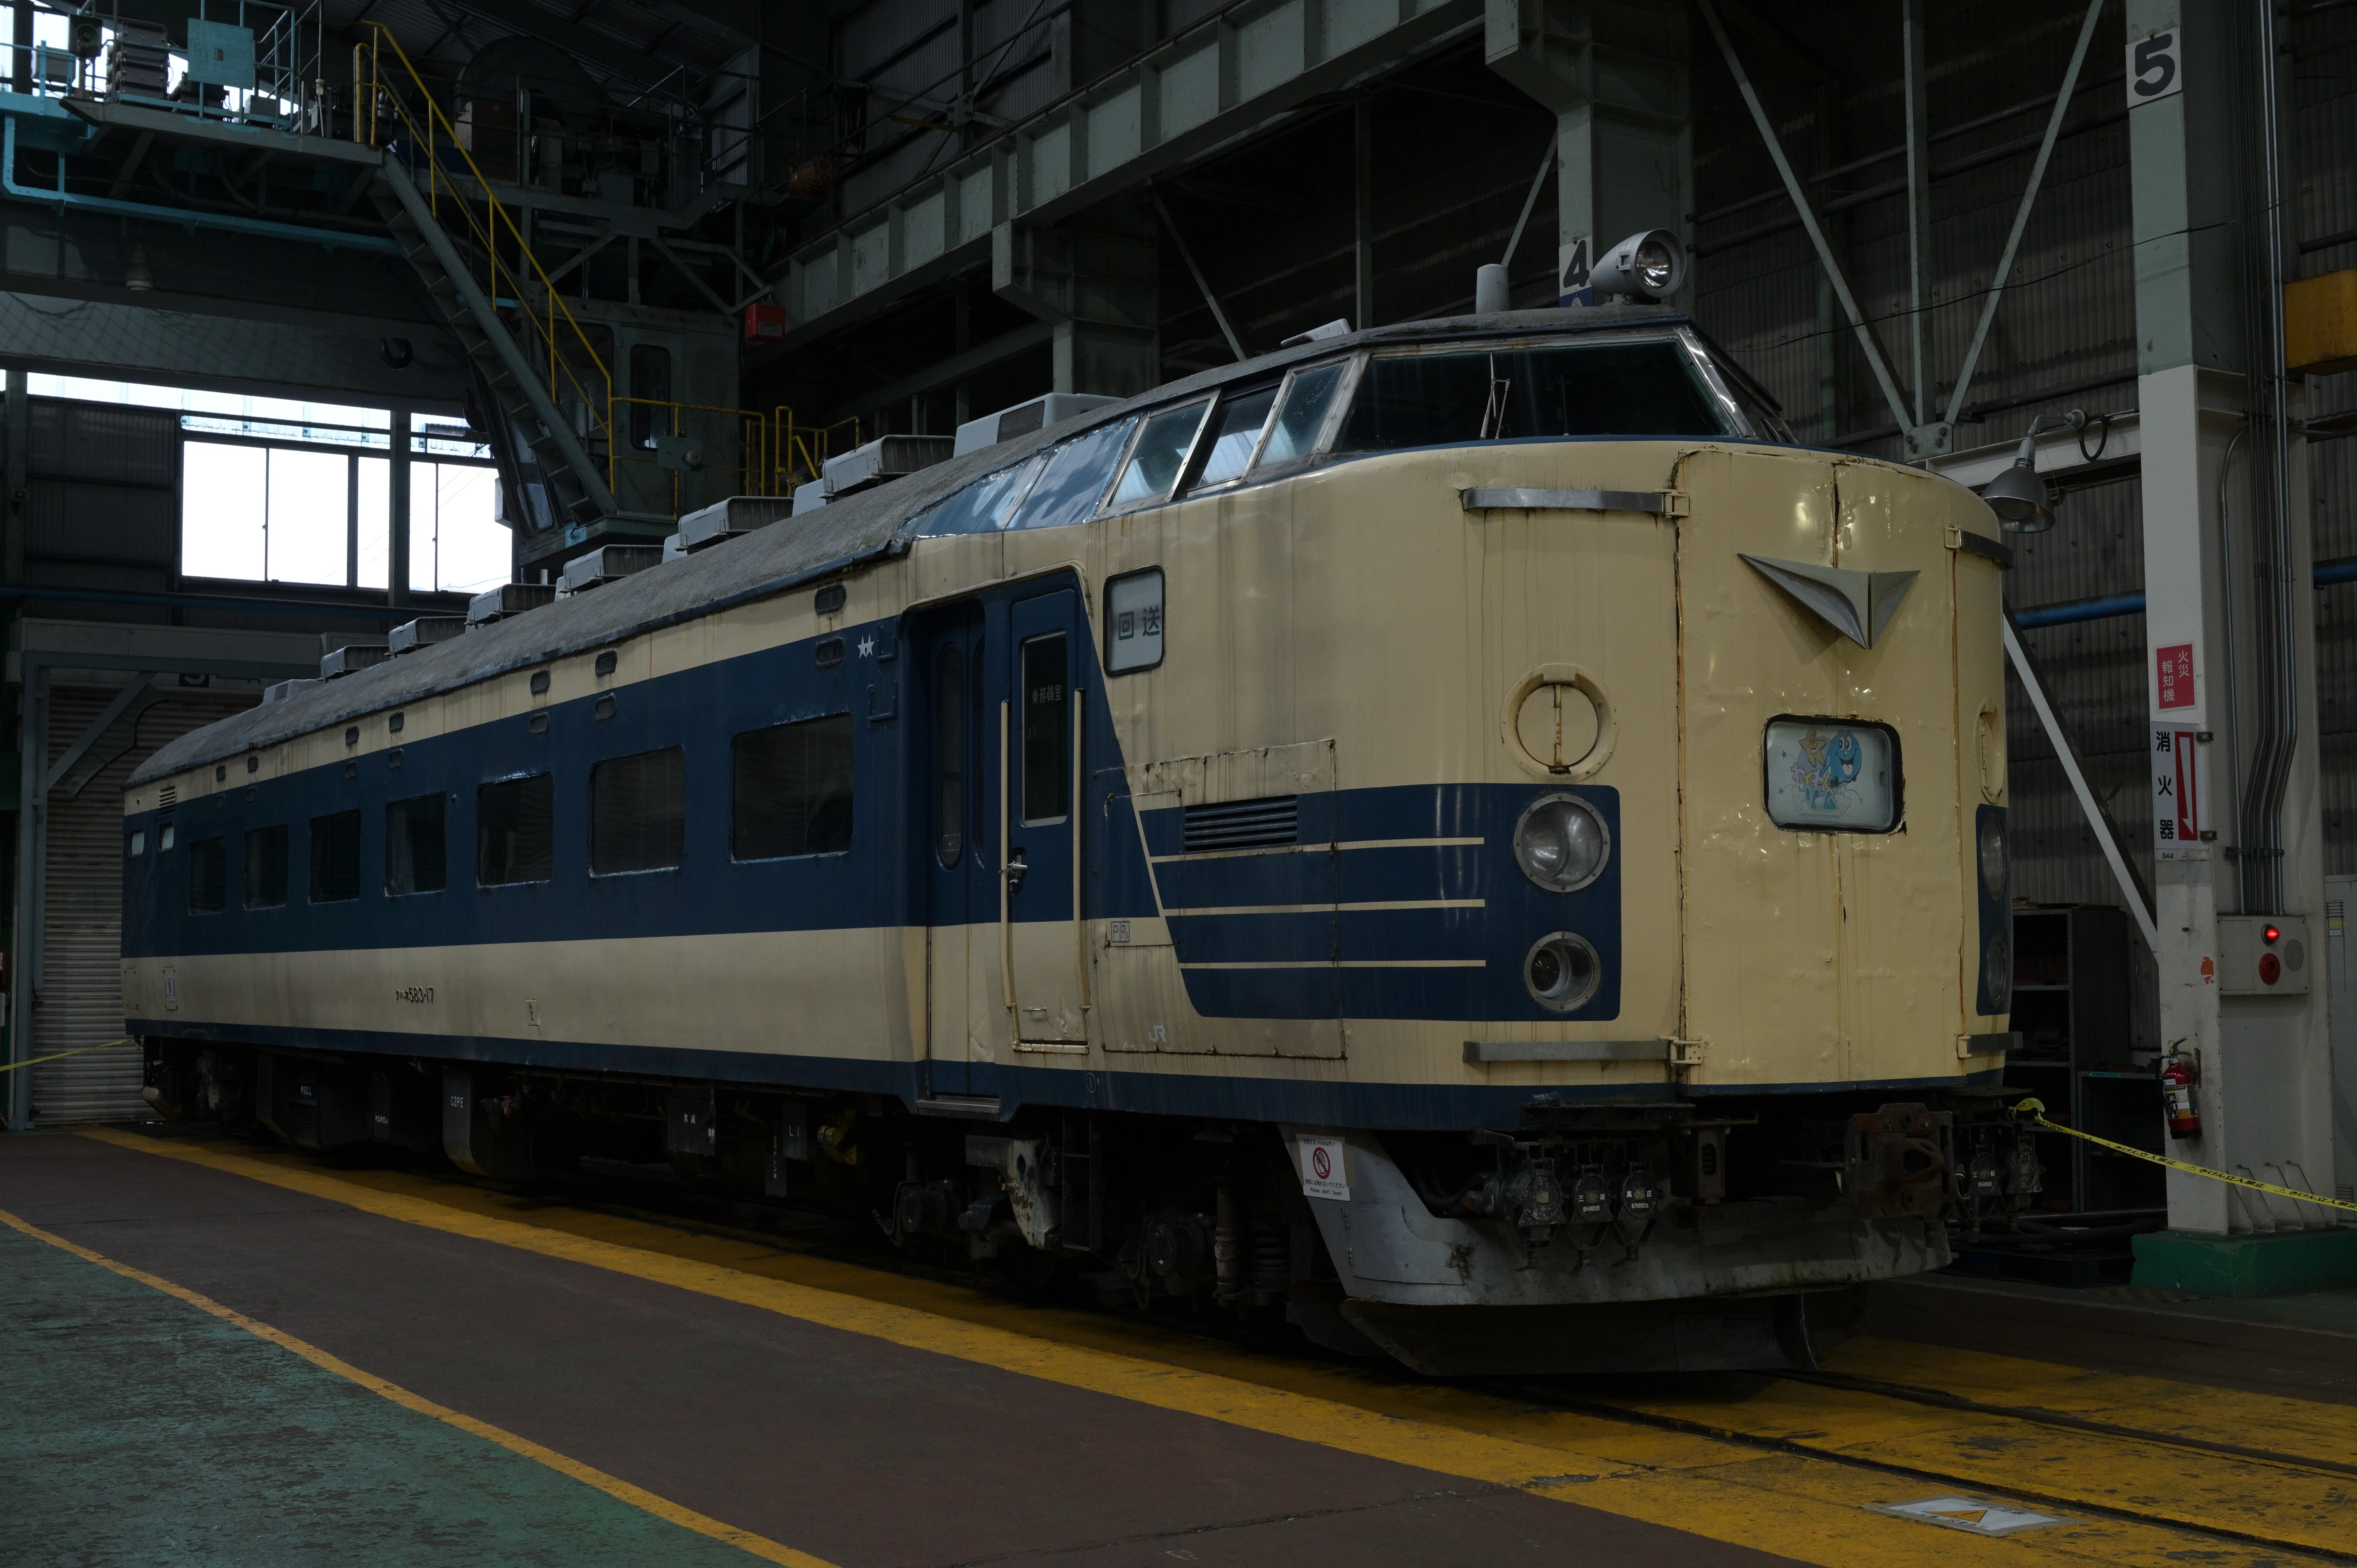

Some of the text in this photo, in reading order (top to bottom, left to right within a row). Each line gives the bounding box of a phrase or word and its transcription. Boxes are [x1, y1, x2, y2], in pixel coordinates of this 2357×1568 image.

[2134, 33, 2175, 97] 5
[1563, 240, 1590, 288] 4
[1118, 605, 1160, 641] 回送
[2178, 650, 2190, 678] 火災
[1032, 684, 1062, 705] 乗務員室
[2161, 660, 2175, 702] 報知機
[2156, 731, 2174, 839] 消火器
[1148, 1024, 1166, 1042] JR
[451, 1096, 464, 1108] C2PE
[2199, 1169, 2265, 1188] きけん立入禁止
